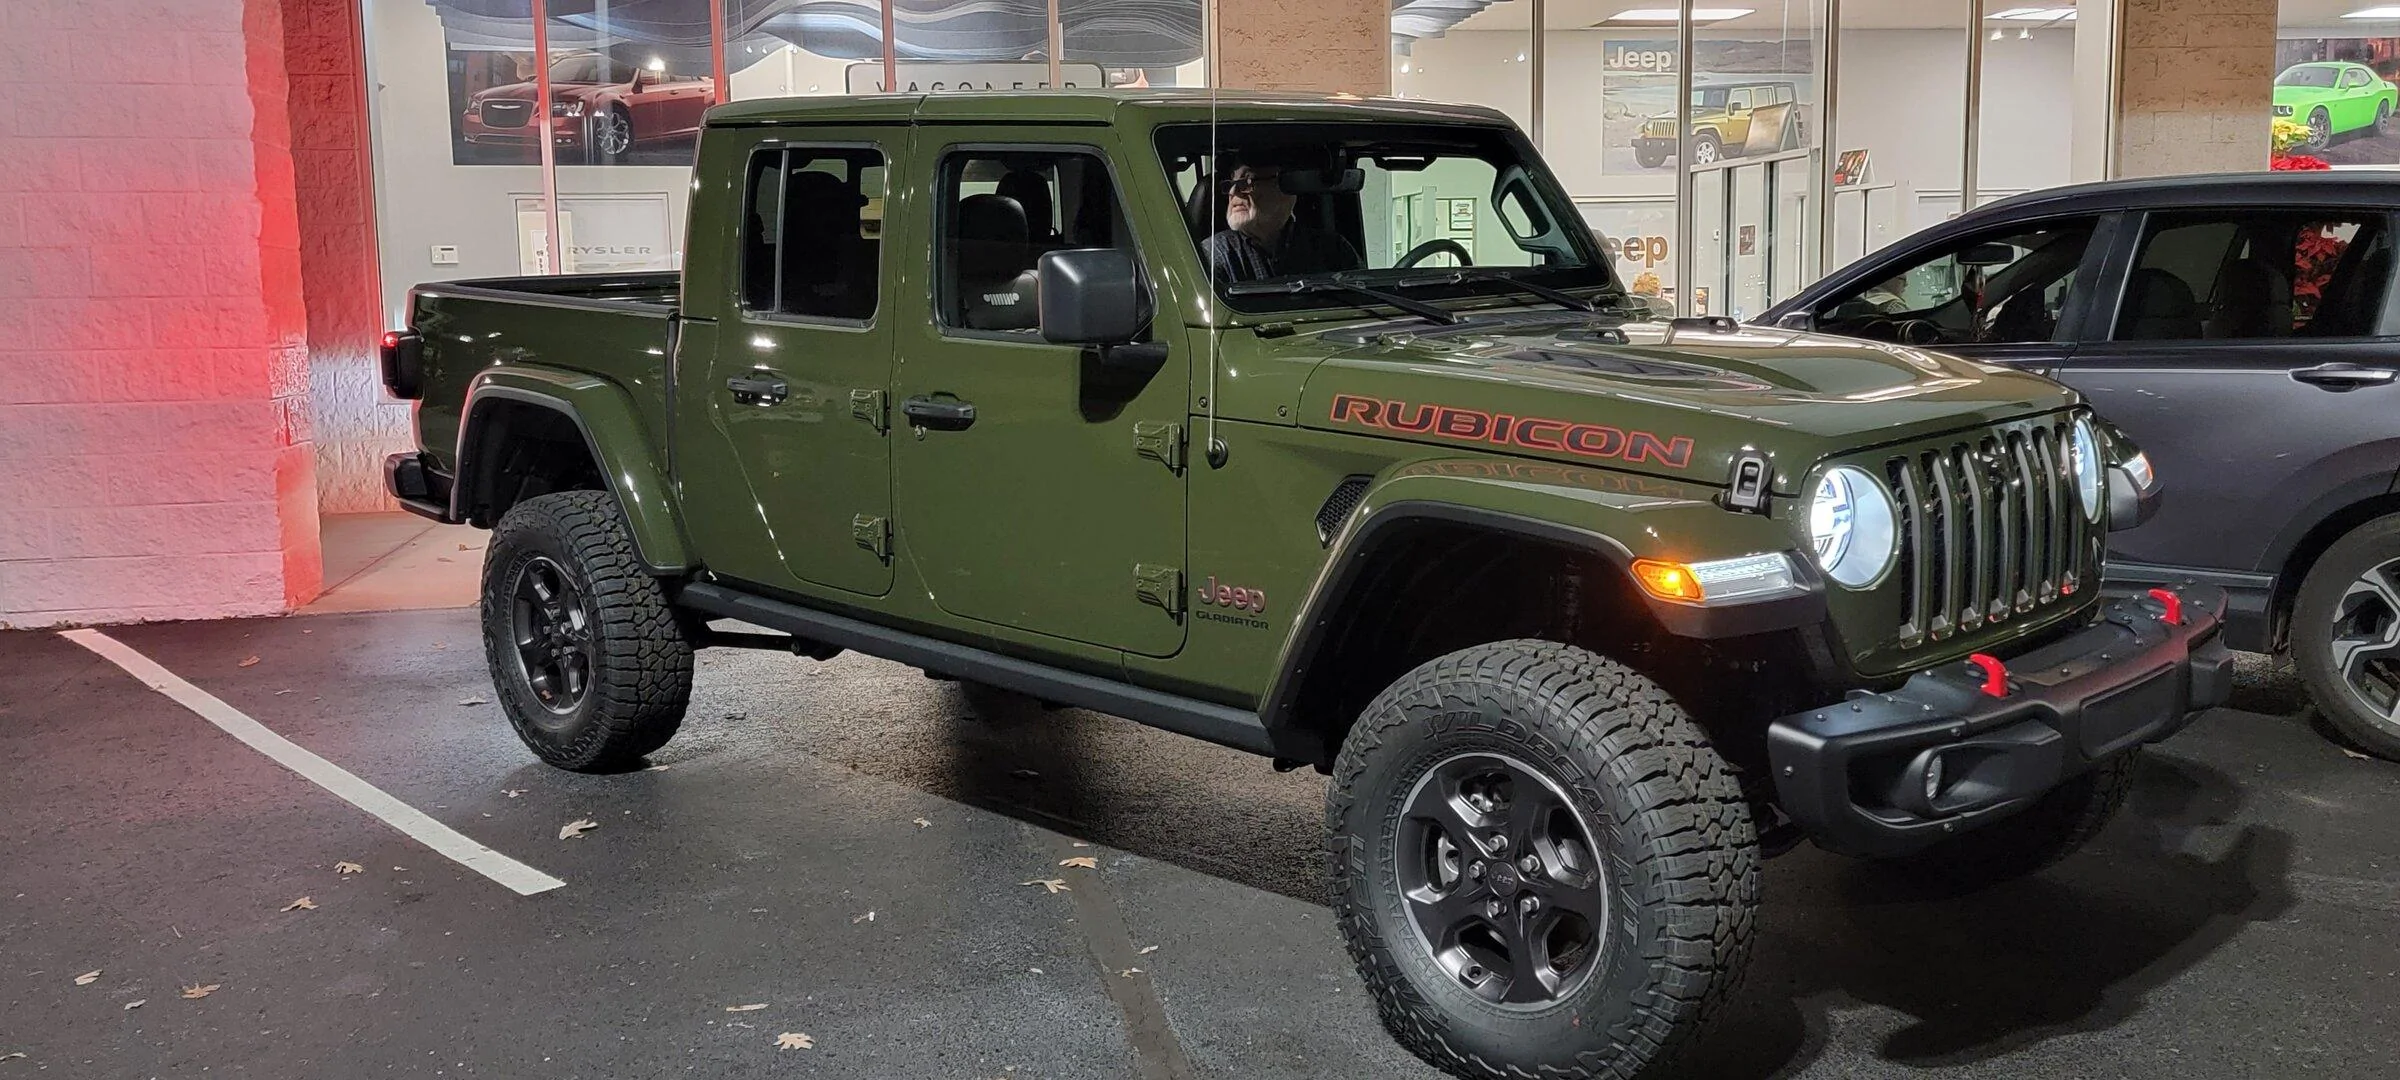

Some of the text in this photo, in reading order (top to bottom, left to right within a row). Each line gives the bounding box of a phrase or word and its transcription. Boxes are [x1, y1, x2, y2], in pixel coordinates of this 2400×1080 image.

[1609, 45, 1672, 72] Jeep
[568, 246, 652, 255] RYSLER
[1607, 236, 1668, 268] eep
[1330, 393, 1695, 468] RUBICON
[1197, 575, 1267, 617] Jeep
[1195, 610, 1270, 631] GLADIATOR
[1423, 709, 1625, 848] WILDPEAK
